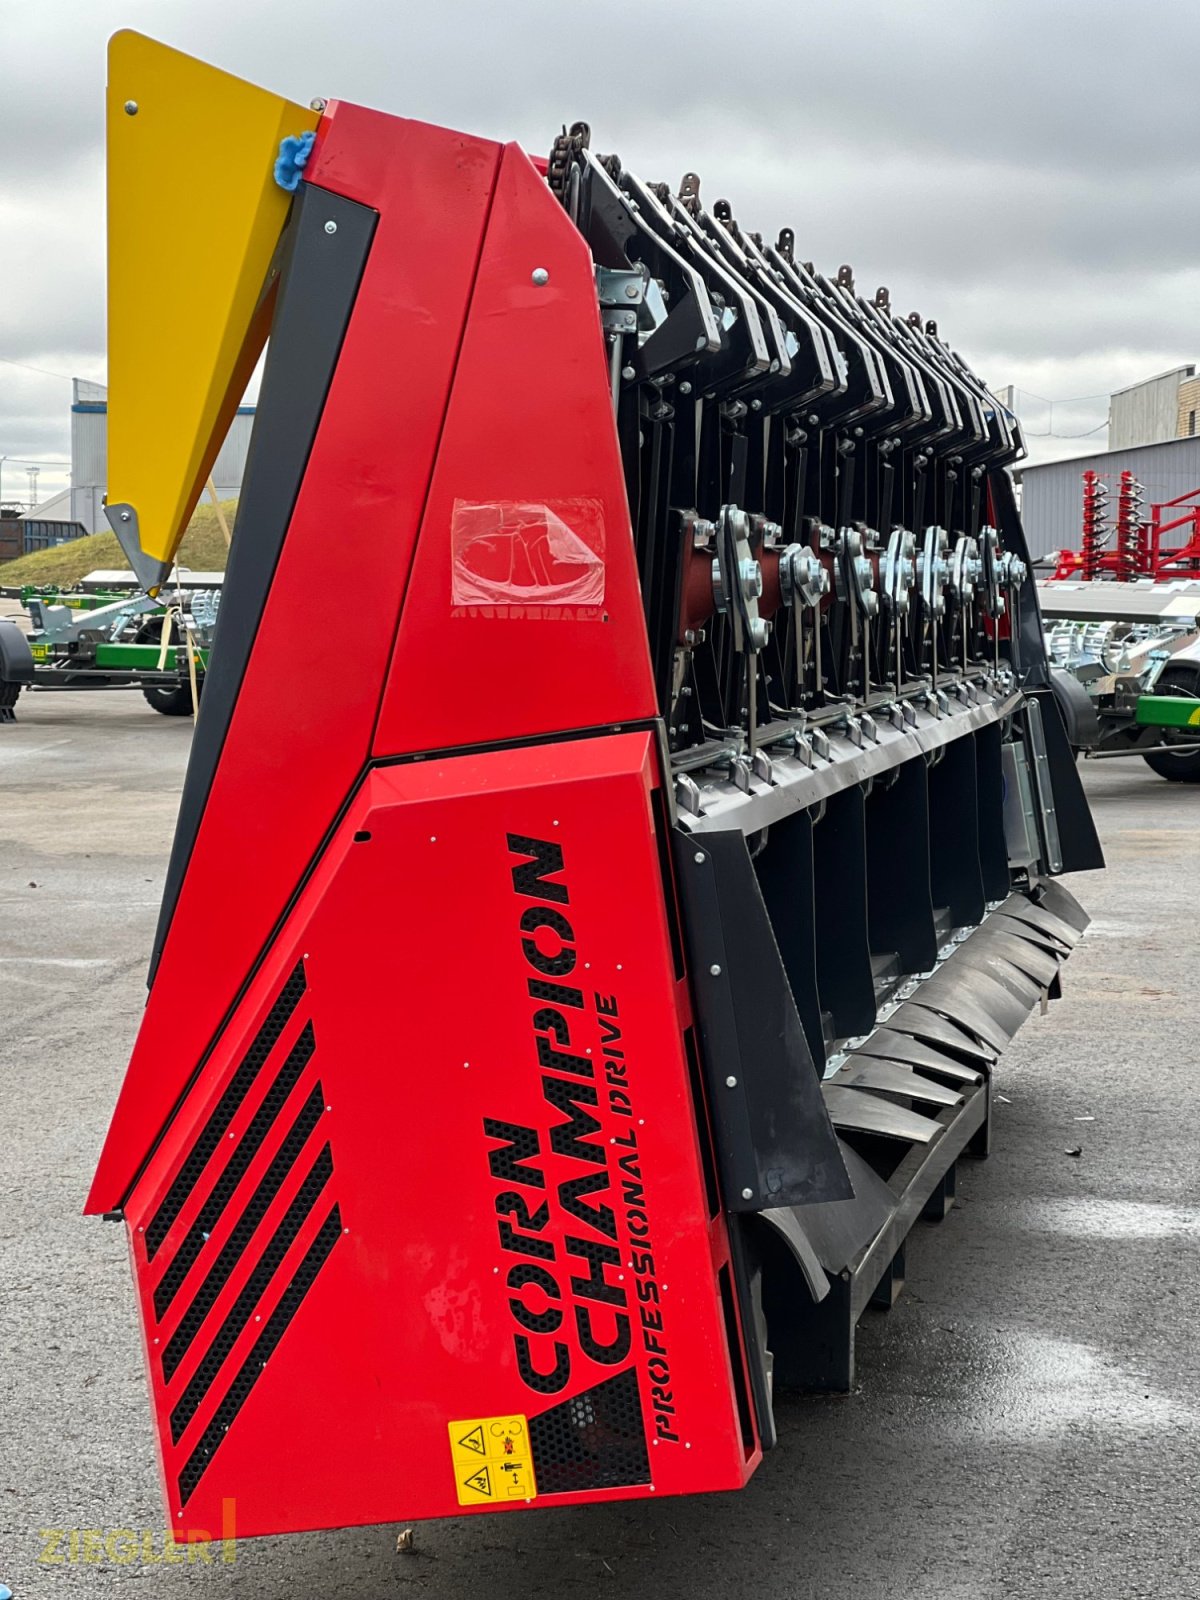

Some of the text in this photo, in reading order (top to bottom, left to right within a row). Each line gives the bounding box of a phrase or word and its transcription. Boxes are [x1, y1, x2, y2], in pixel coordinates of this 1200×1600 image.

[483, 1117, 570, 1394] CORN
[506, 832, 631, 1365] CHAMPION
[594, 991, 679, 1442] PROFESSIONAL DRIVE
